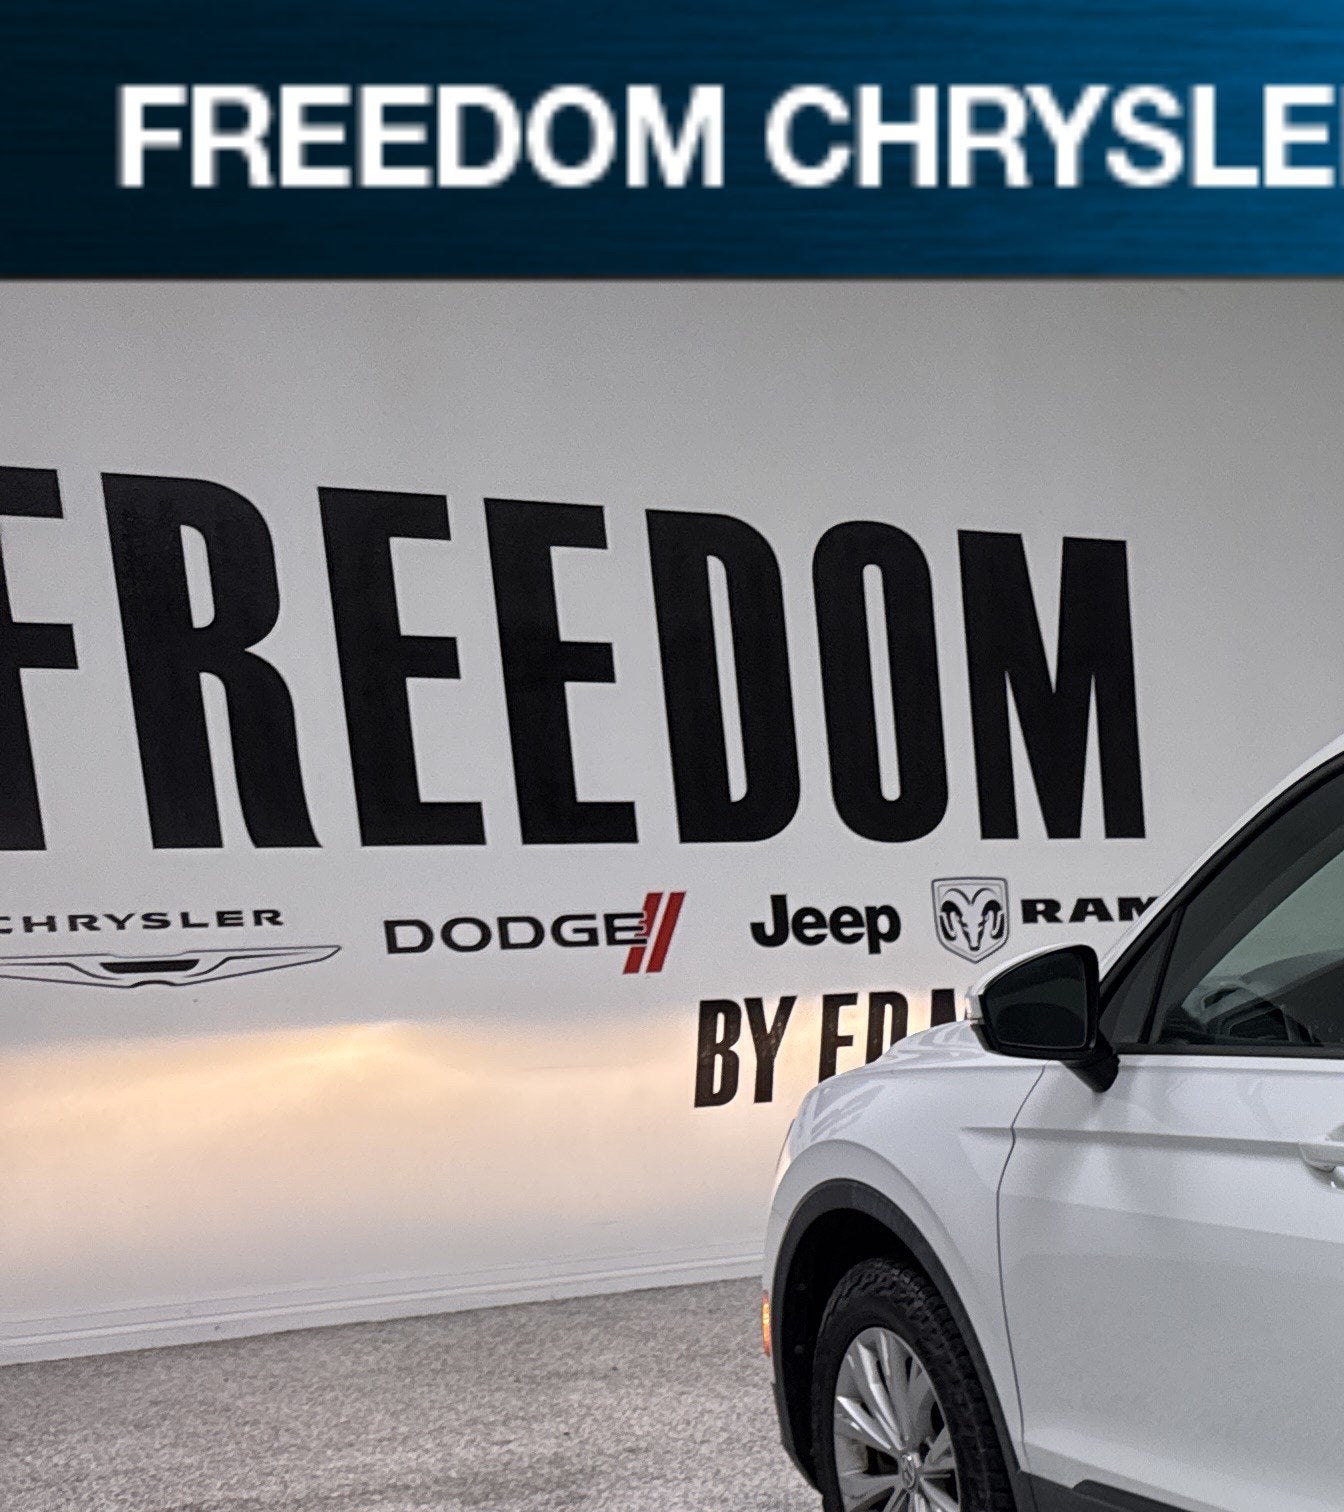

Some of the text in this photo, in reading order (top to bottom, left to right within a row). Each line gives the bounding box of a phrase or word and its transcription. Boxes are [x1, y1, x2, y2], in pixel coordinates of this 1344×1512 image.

[384, 911, 648, 955] DODGE
[750, 894, 902, 955] Jeep
[694, 994, 797, 1108] BY
